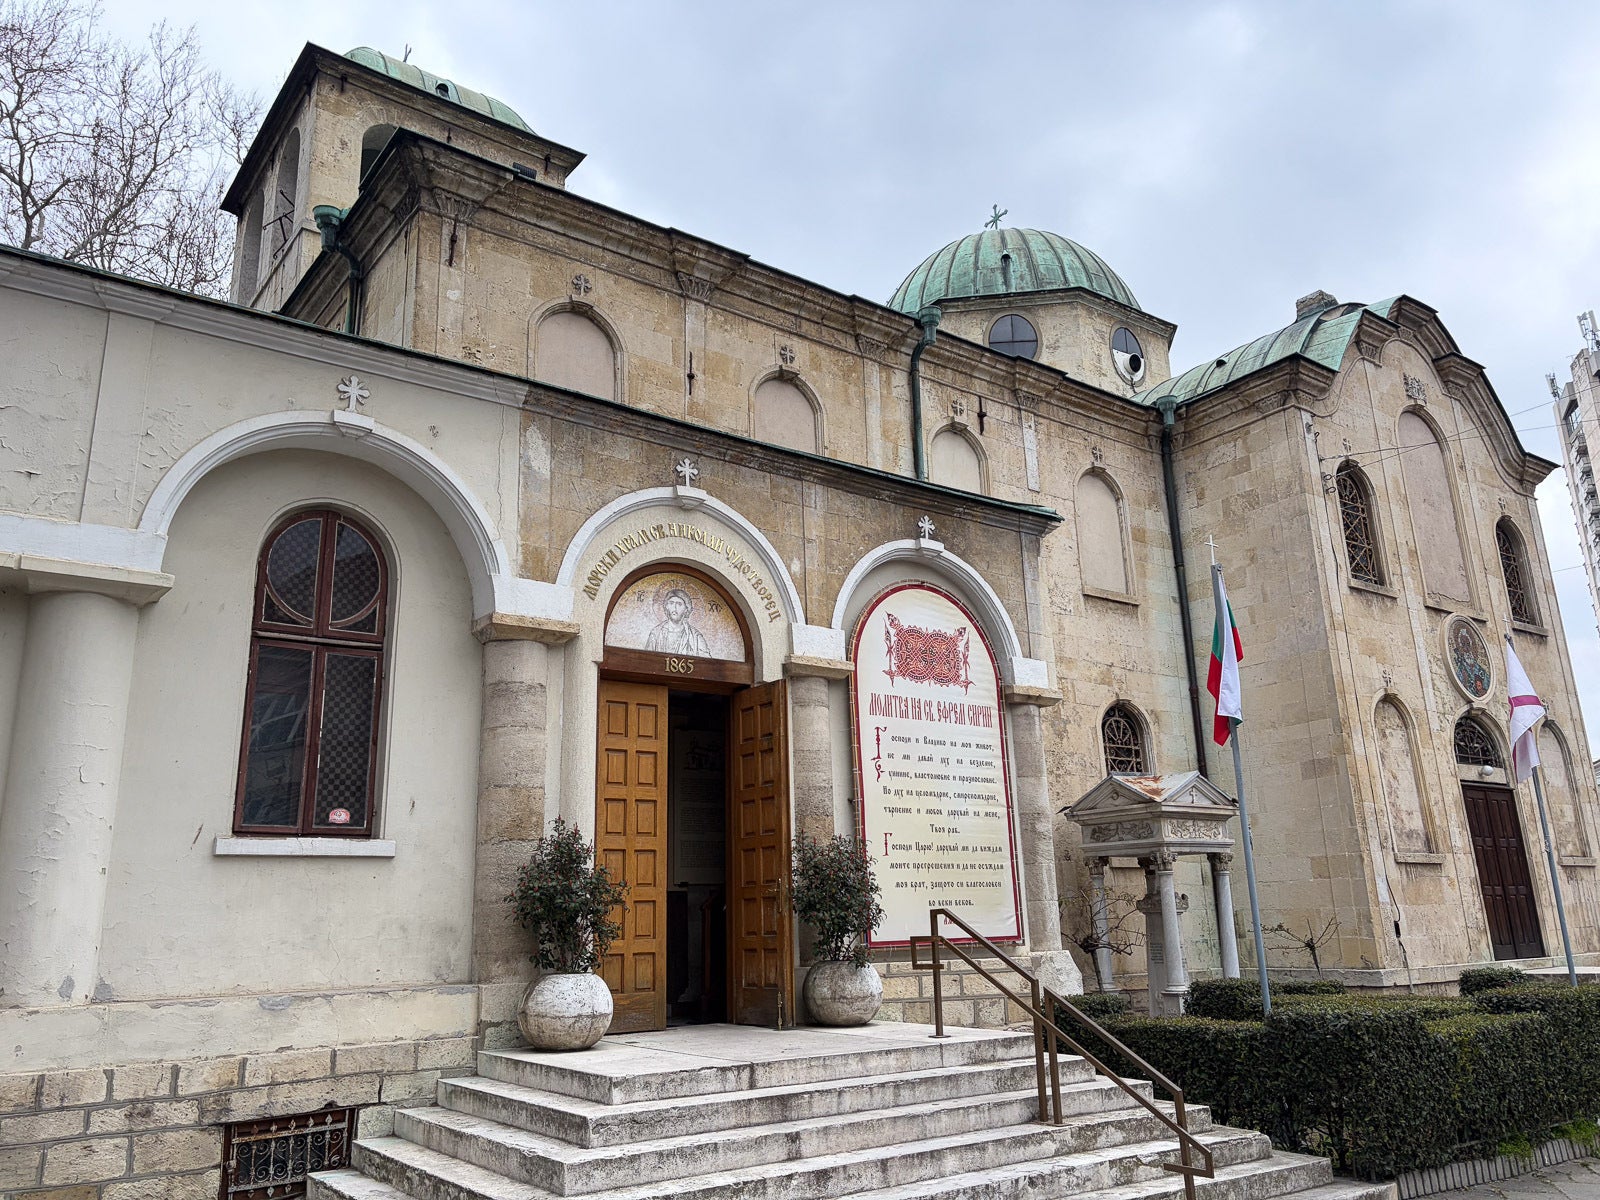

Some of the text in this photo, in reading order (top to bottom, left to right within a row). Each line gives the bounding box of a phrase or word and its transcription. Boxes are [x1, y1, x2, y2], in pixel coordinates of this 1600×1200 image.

[582, 522, 782, 623] МОРСКИ ХРАМ СВ. НИКОЛАЙ ЧУДОТВОРЕЦ
[664, 657, 694, 674] 1865
[869, 693, 909, 719] МОЛИТВА
[911, 698, 922, 720] НА
[924, 699, 936, 722] СВ.
[937, 701, 966, 725] ЕФРЕМ
